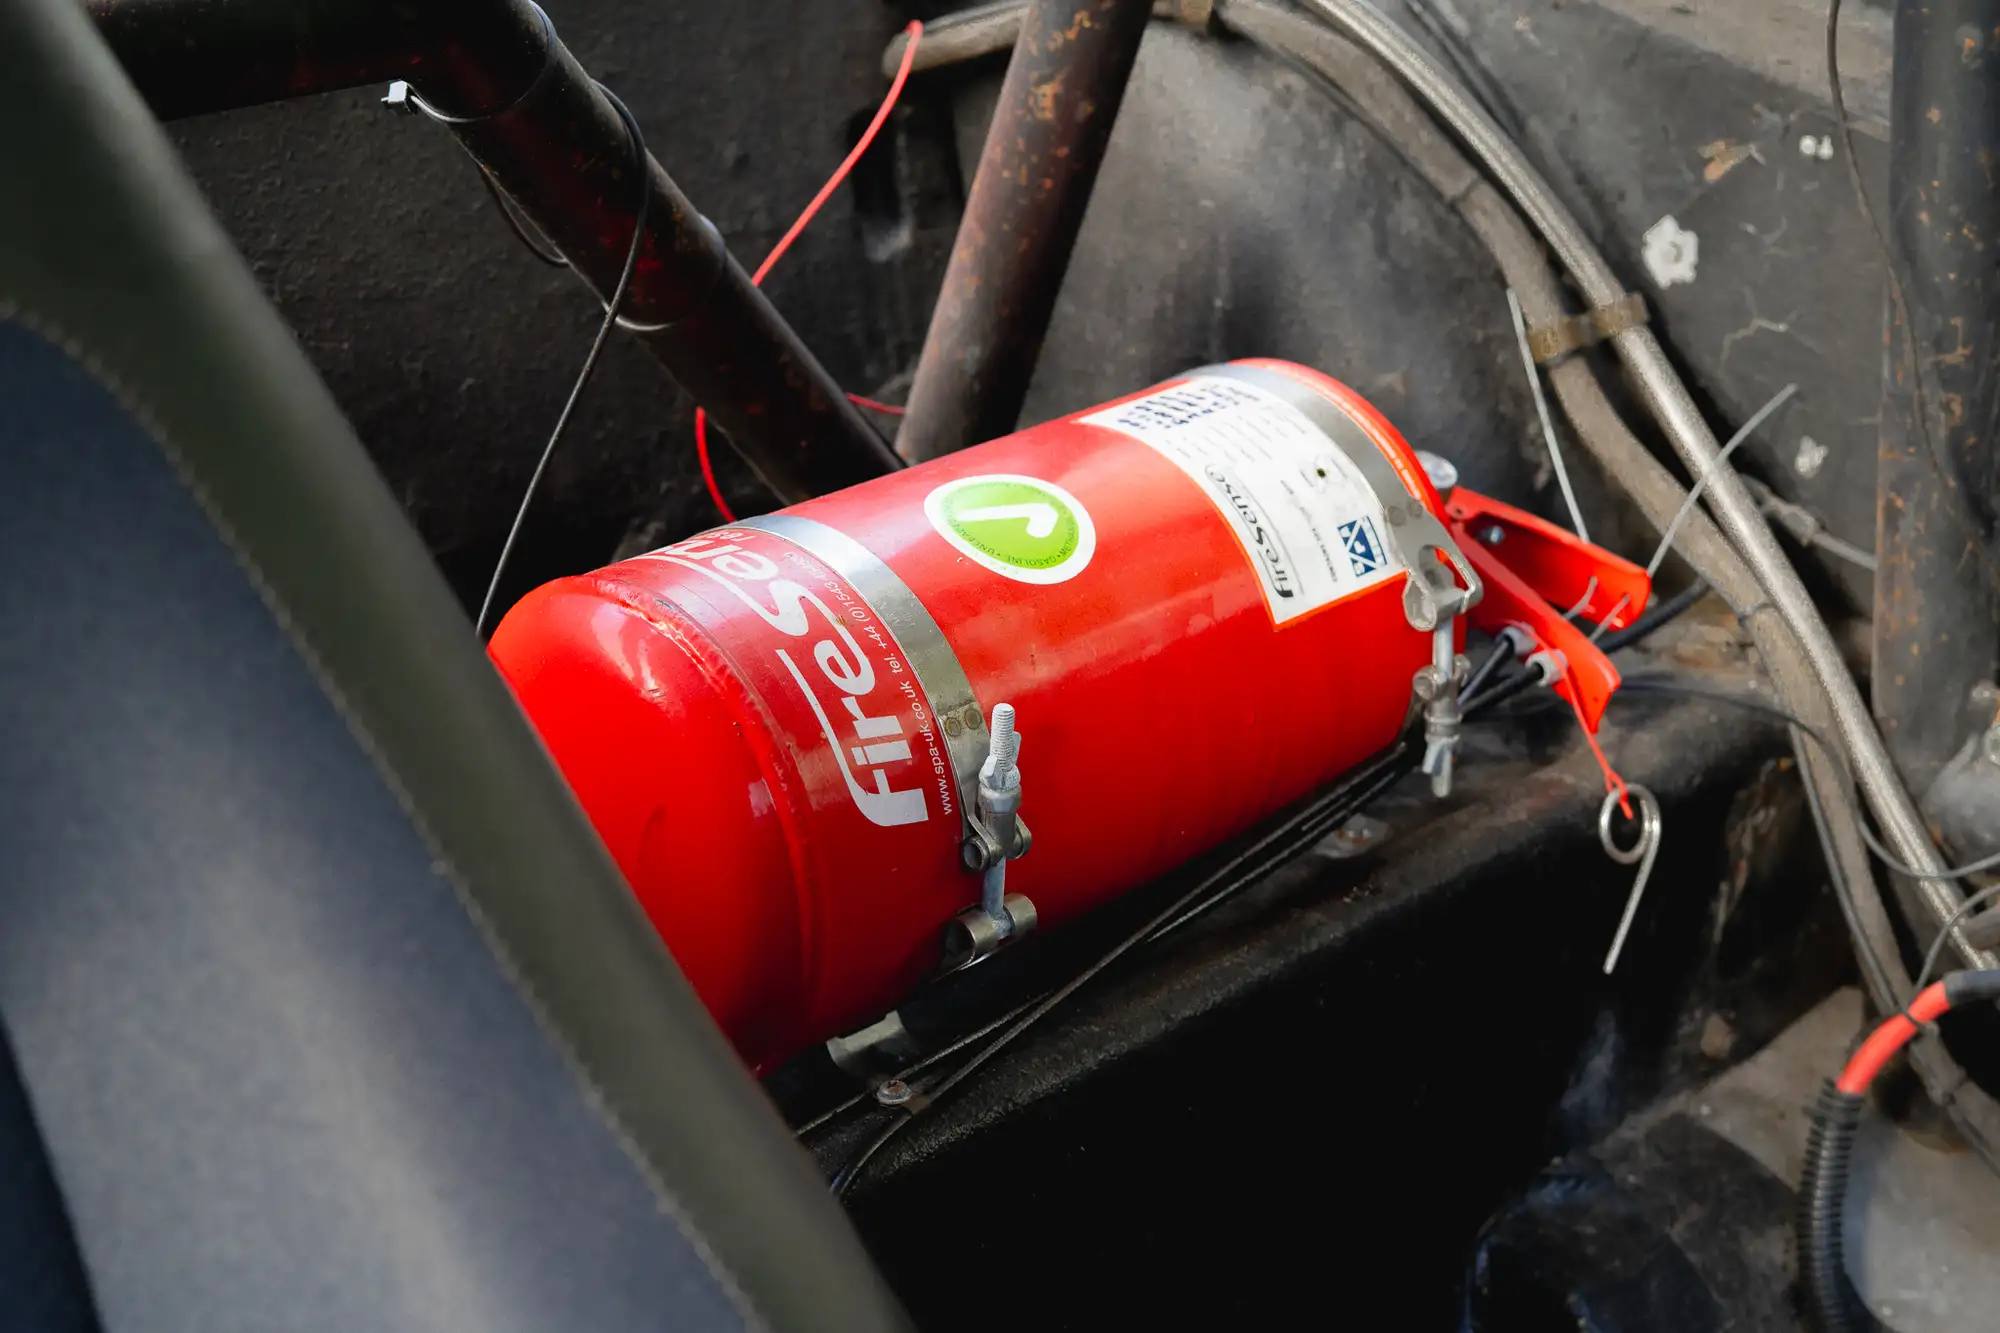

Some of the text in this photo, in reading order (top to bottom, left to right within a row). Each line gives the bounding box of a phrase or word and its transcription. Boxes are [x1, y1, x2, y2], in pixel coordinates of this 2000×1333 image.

[863, 624, 888, 650] +44
[884, 652, 904, 677] tel.
[630, 539, 929, 826] FireSen
[899, 680, 953, 816] www.spa-uk.co.uk
